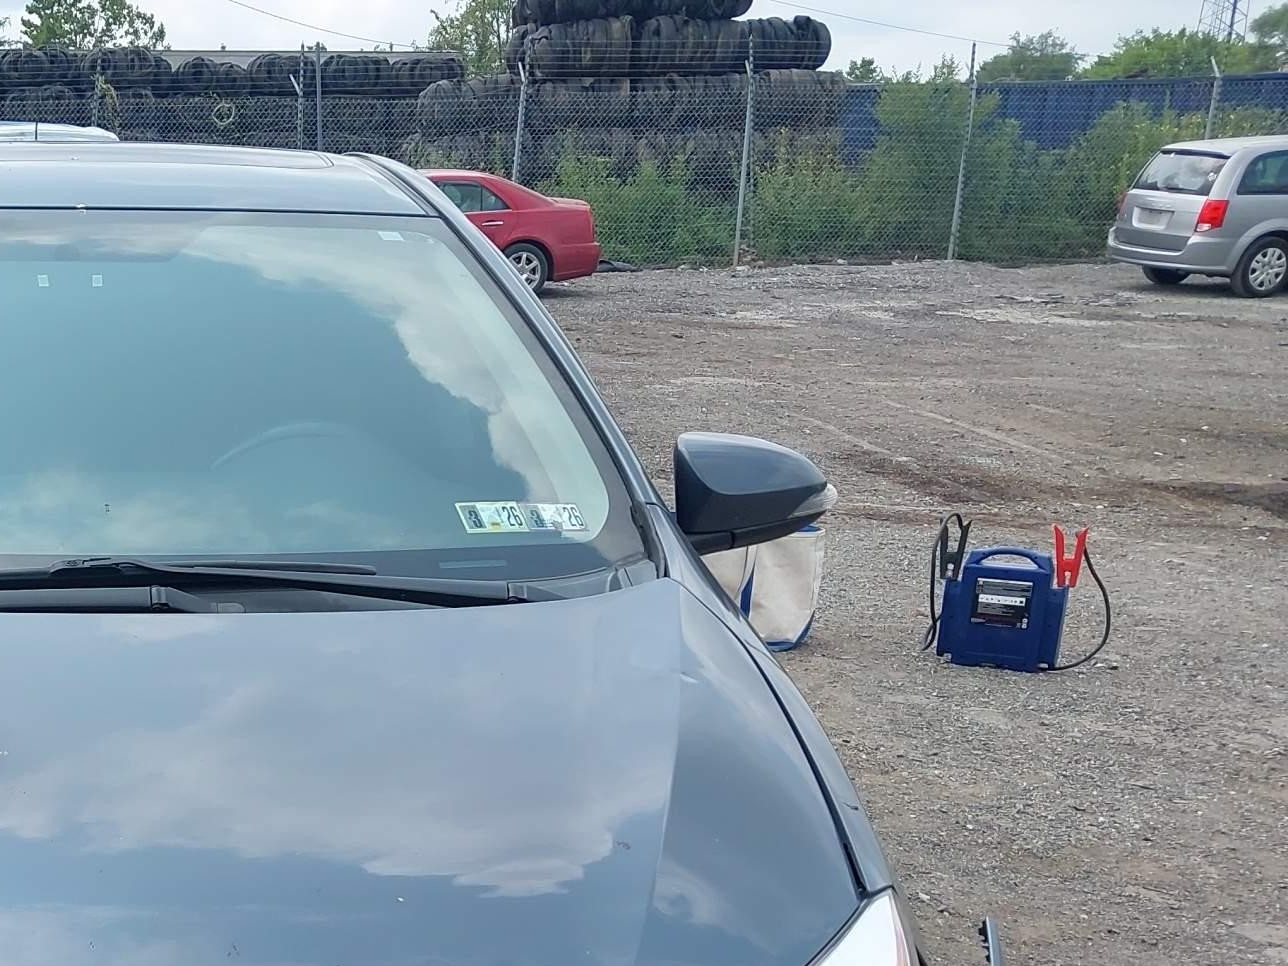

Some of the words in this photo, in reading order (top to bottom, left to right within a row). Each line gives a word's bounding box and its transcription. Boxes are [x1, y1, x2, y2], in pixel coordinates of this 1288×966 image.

[468, 509, 484, 529] 3
[501, 505, 524, 527] 26
[562, 506, 585, 527] 26
